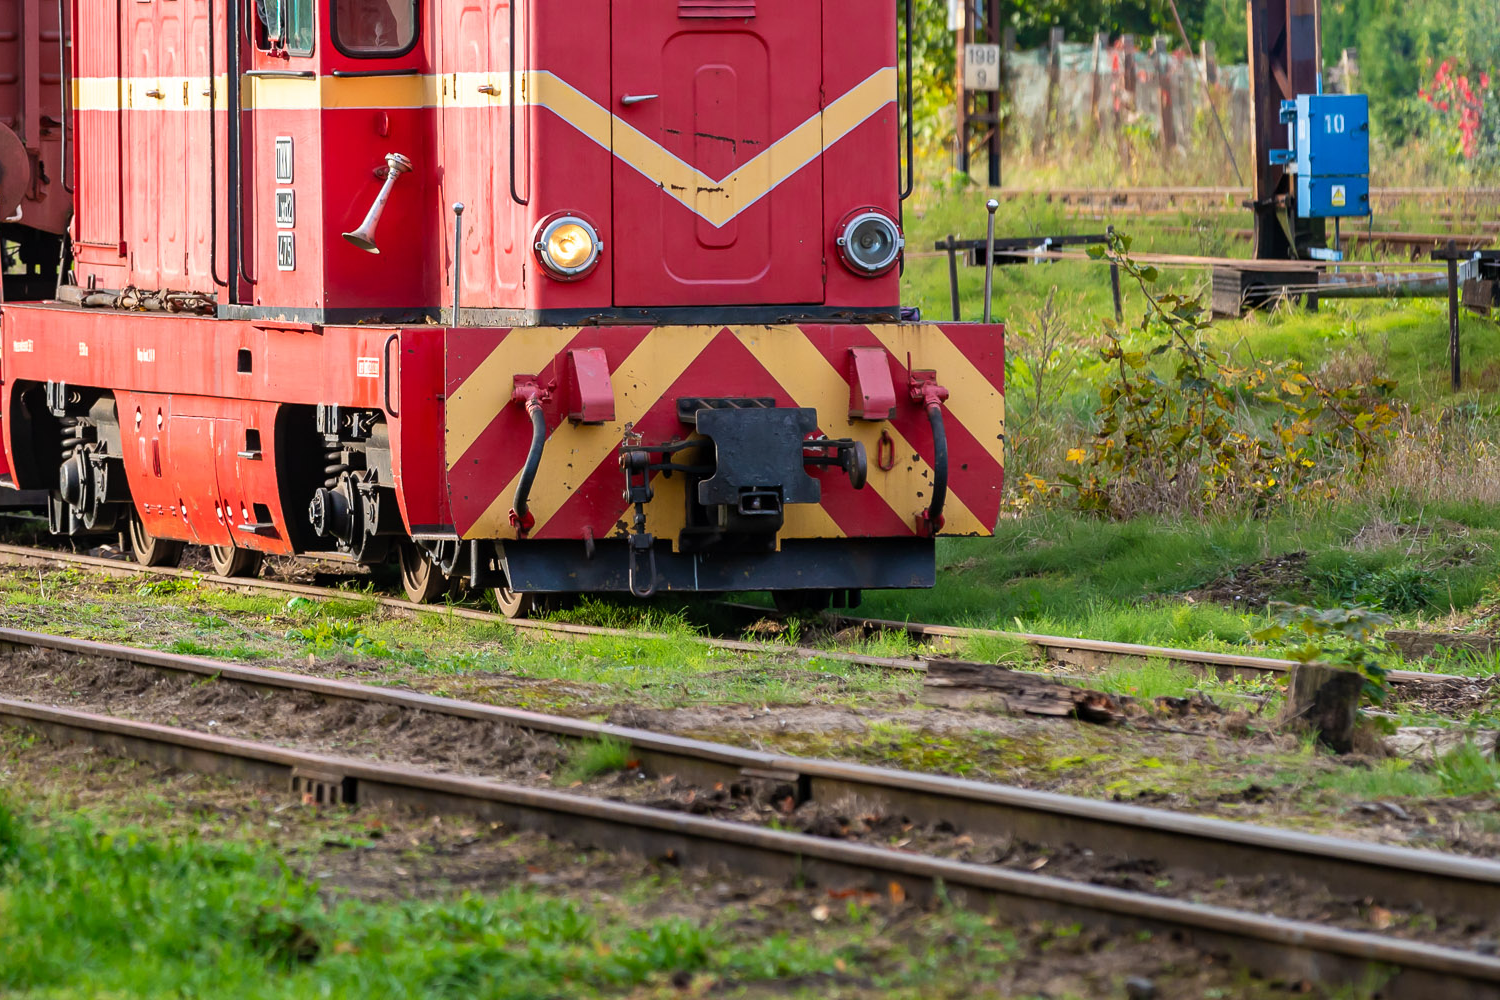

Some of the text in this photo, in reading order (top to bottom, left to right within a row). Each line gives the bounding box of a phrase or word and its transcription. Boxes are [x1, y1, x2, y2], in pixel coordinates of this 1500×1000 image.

[969, 47, 996, 66] 198
[977, 69, 987, 88] 9
[1324, 113, 1345, 134] 10
[276, 193, 292, 221] Lxd2
[278, 235, 293, 265] 475
